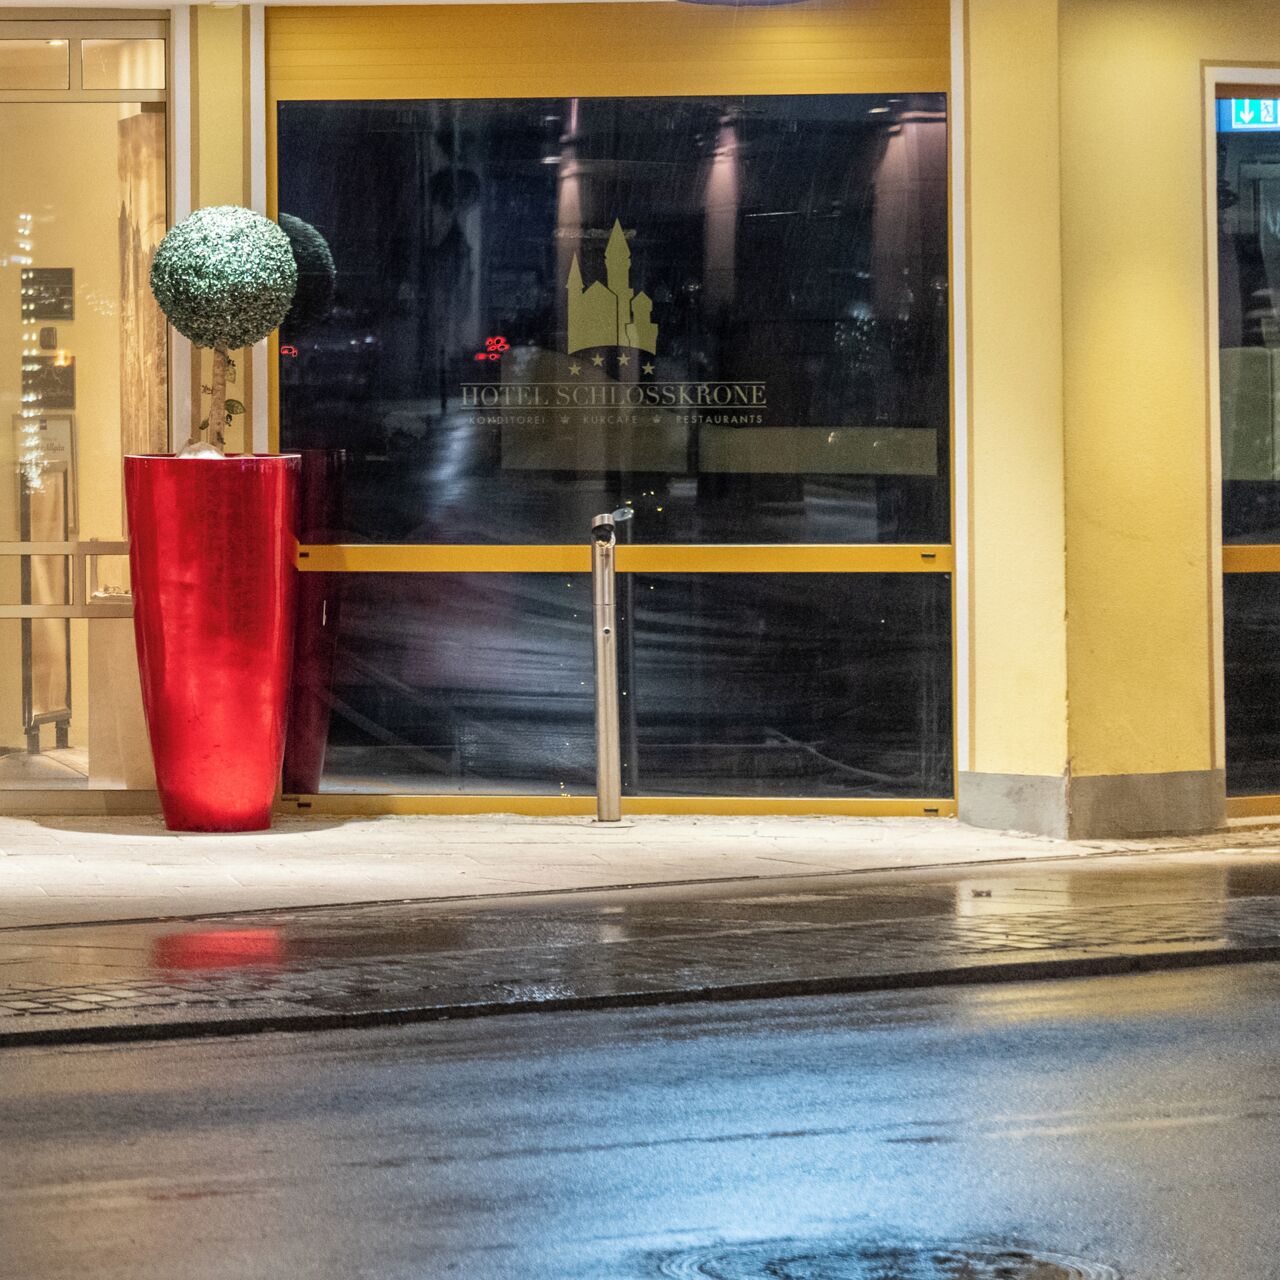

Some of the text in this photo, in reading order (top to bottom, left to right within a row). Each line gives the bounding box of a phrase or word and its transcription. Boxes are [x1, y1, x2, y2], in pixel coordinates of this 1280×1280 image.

[461, 384, 767, 406] HOTEL SCHLOSSKRONE
[676, 414, 763, 424] RESTAURANTS
